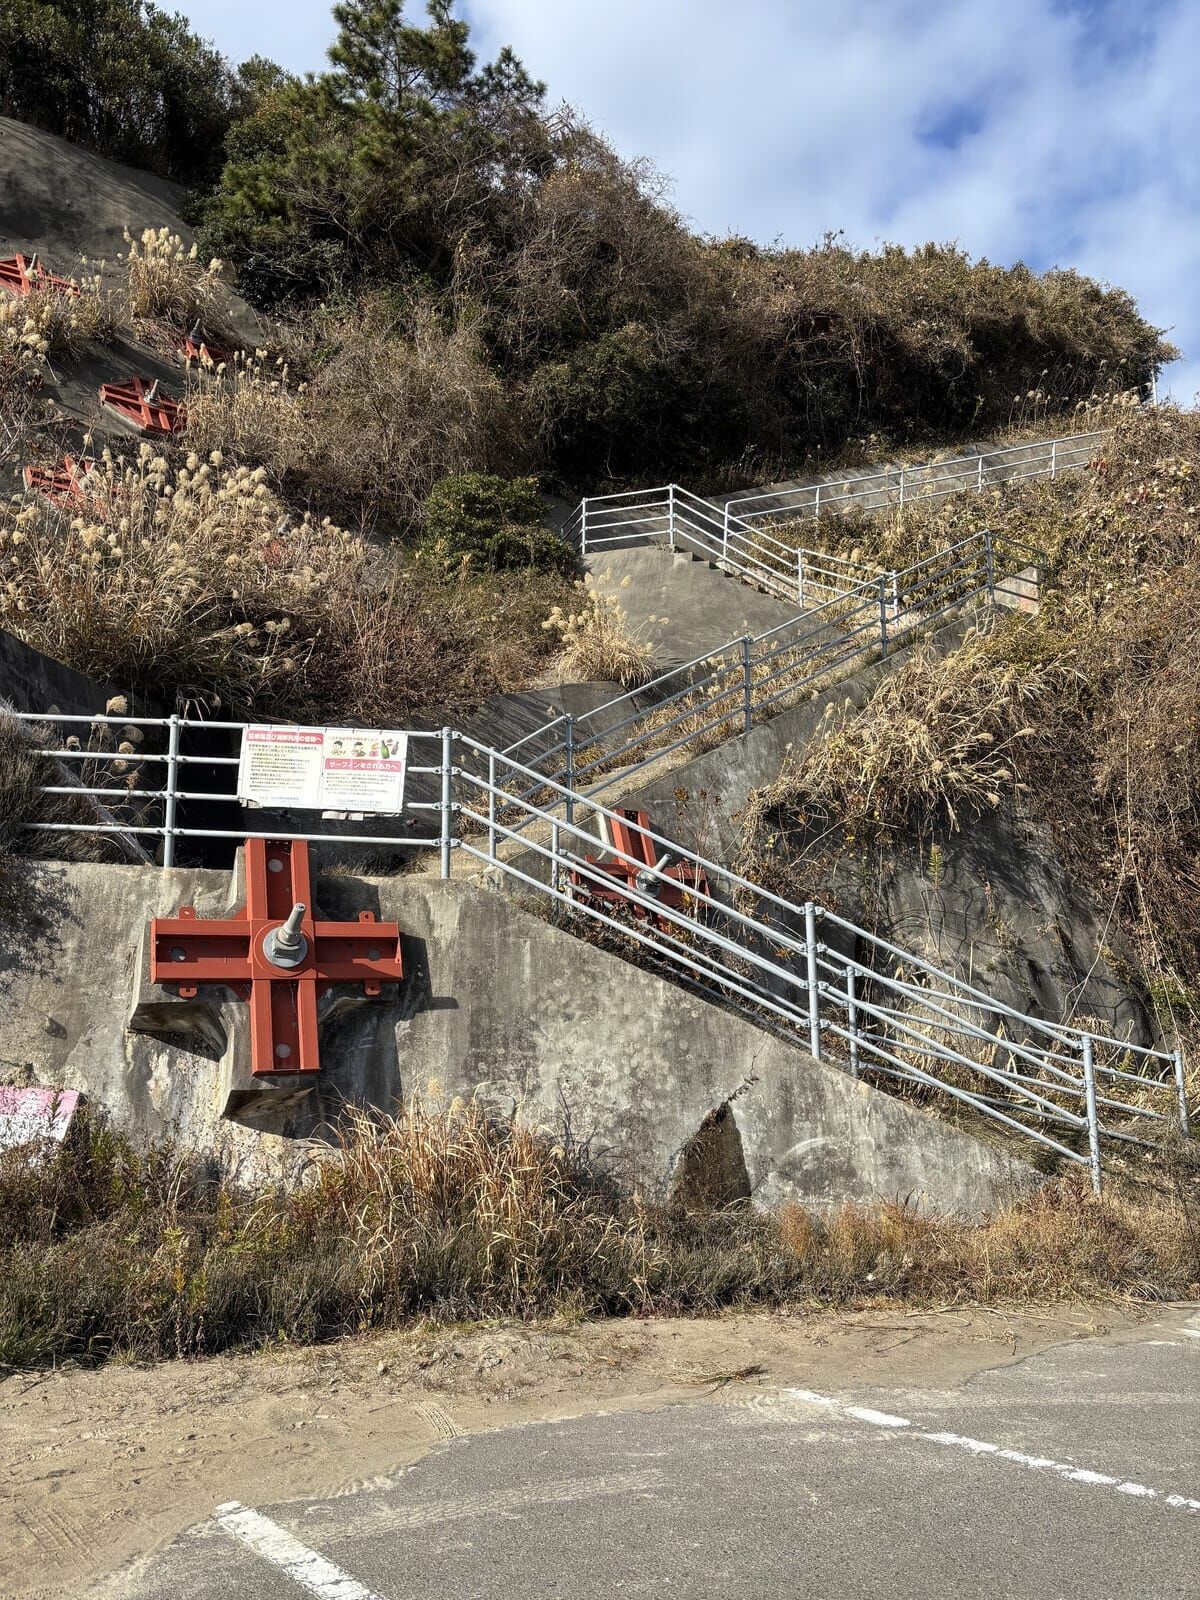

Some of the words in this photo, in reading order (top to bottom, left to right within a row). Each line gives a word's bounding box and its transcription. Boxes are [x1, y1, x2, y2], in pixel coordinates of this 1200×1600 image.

[329, 761, 397, 770] サーフィンをされる方へ
